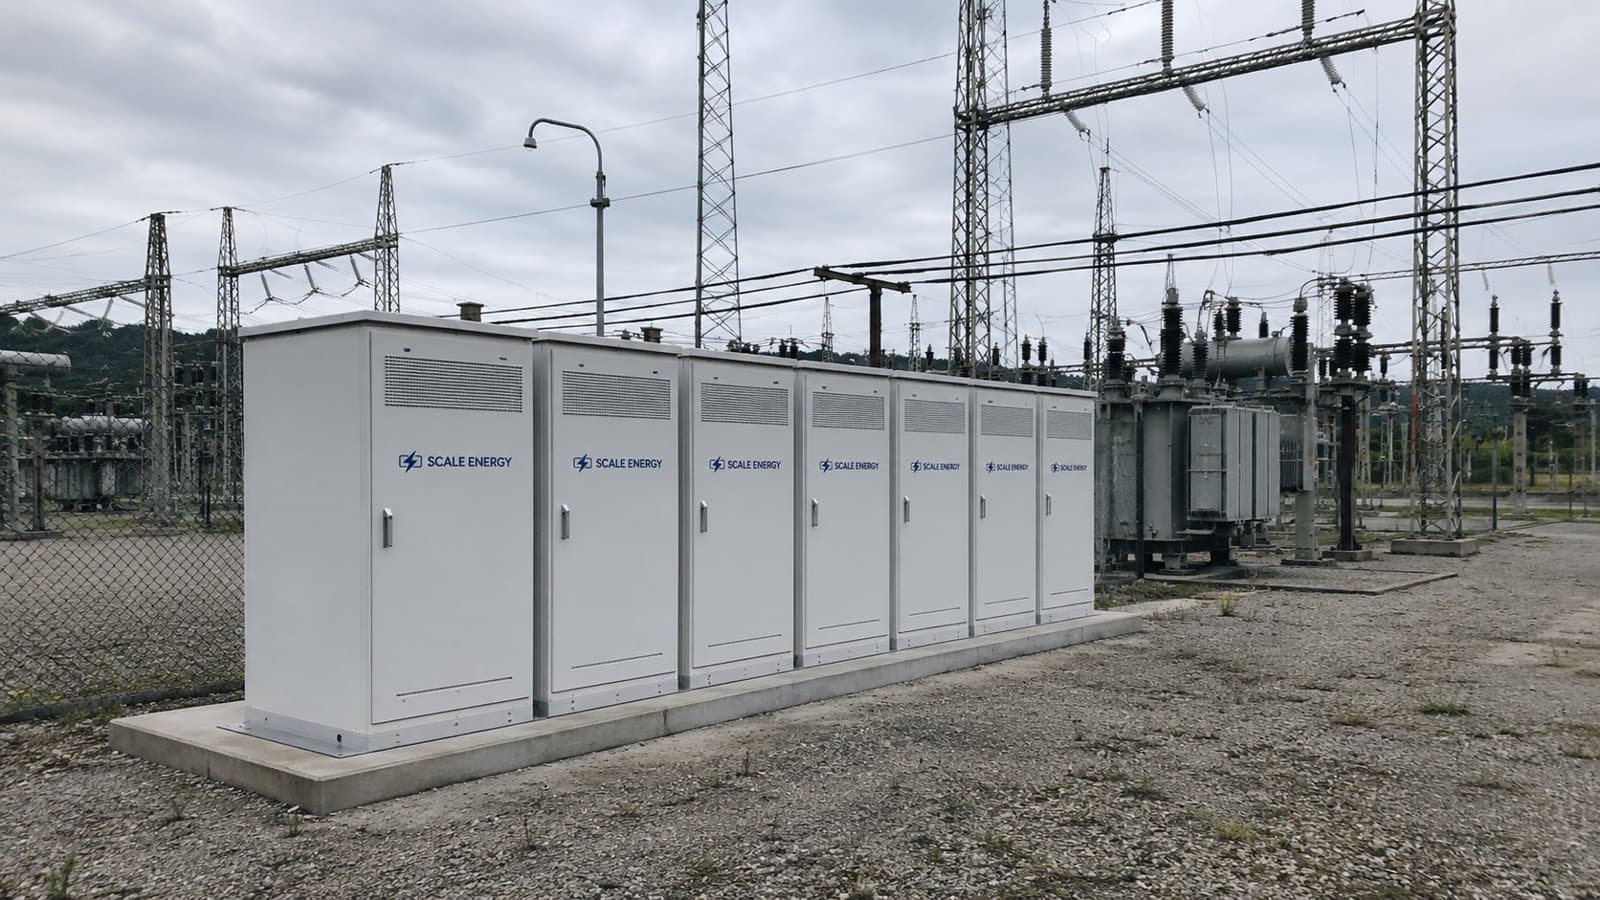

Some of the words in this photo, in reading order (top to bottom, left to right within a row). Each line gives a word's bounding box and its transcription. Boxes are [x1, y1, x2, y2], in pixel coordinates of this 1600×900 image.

[427, 456, 465, 468] SCALE
[468, 456, 512, 468] ENERGY
[596, 458, 626, 469] SCALE
[628, 458, 662, 469] ENERGY
[728, 460, 752, 470] SCALE
[753, 460, 781, 470] ENERGY
[834, 462, 855, 470] SCALE
[856, 462, 879, 470] ENERGY
[923, 463, 940, 471] SCALE
